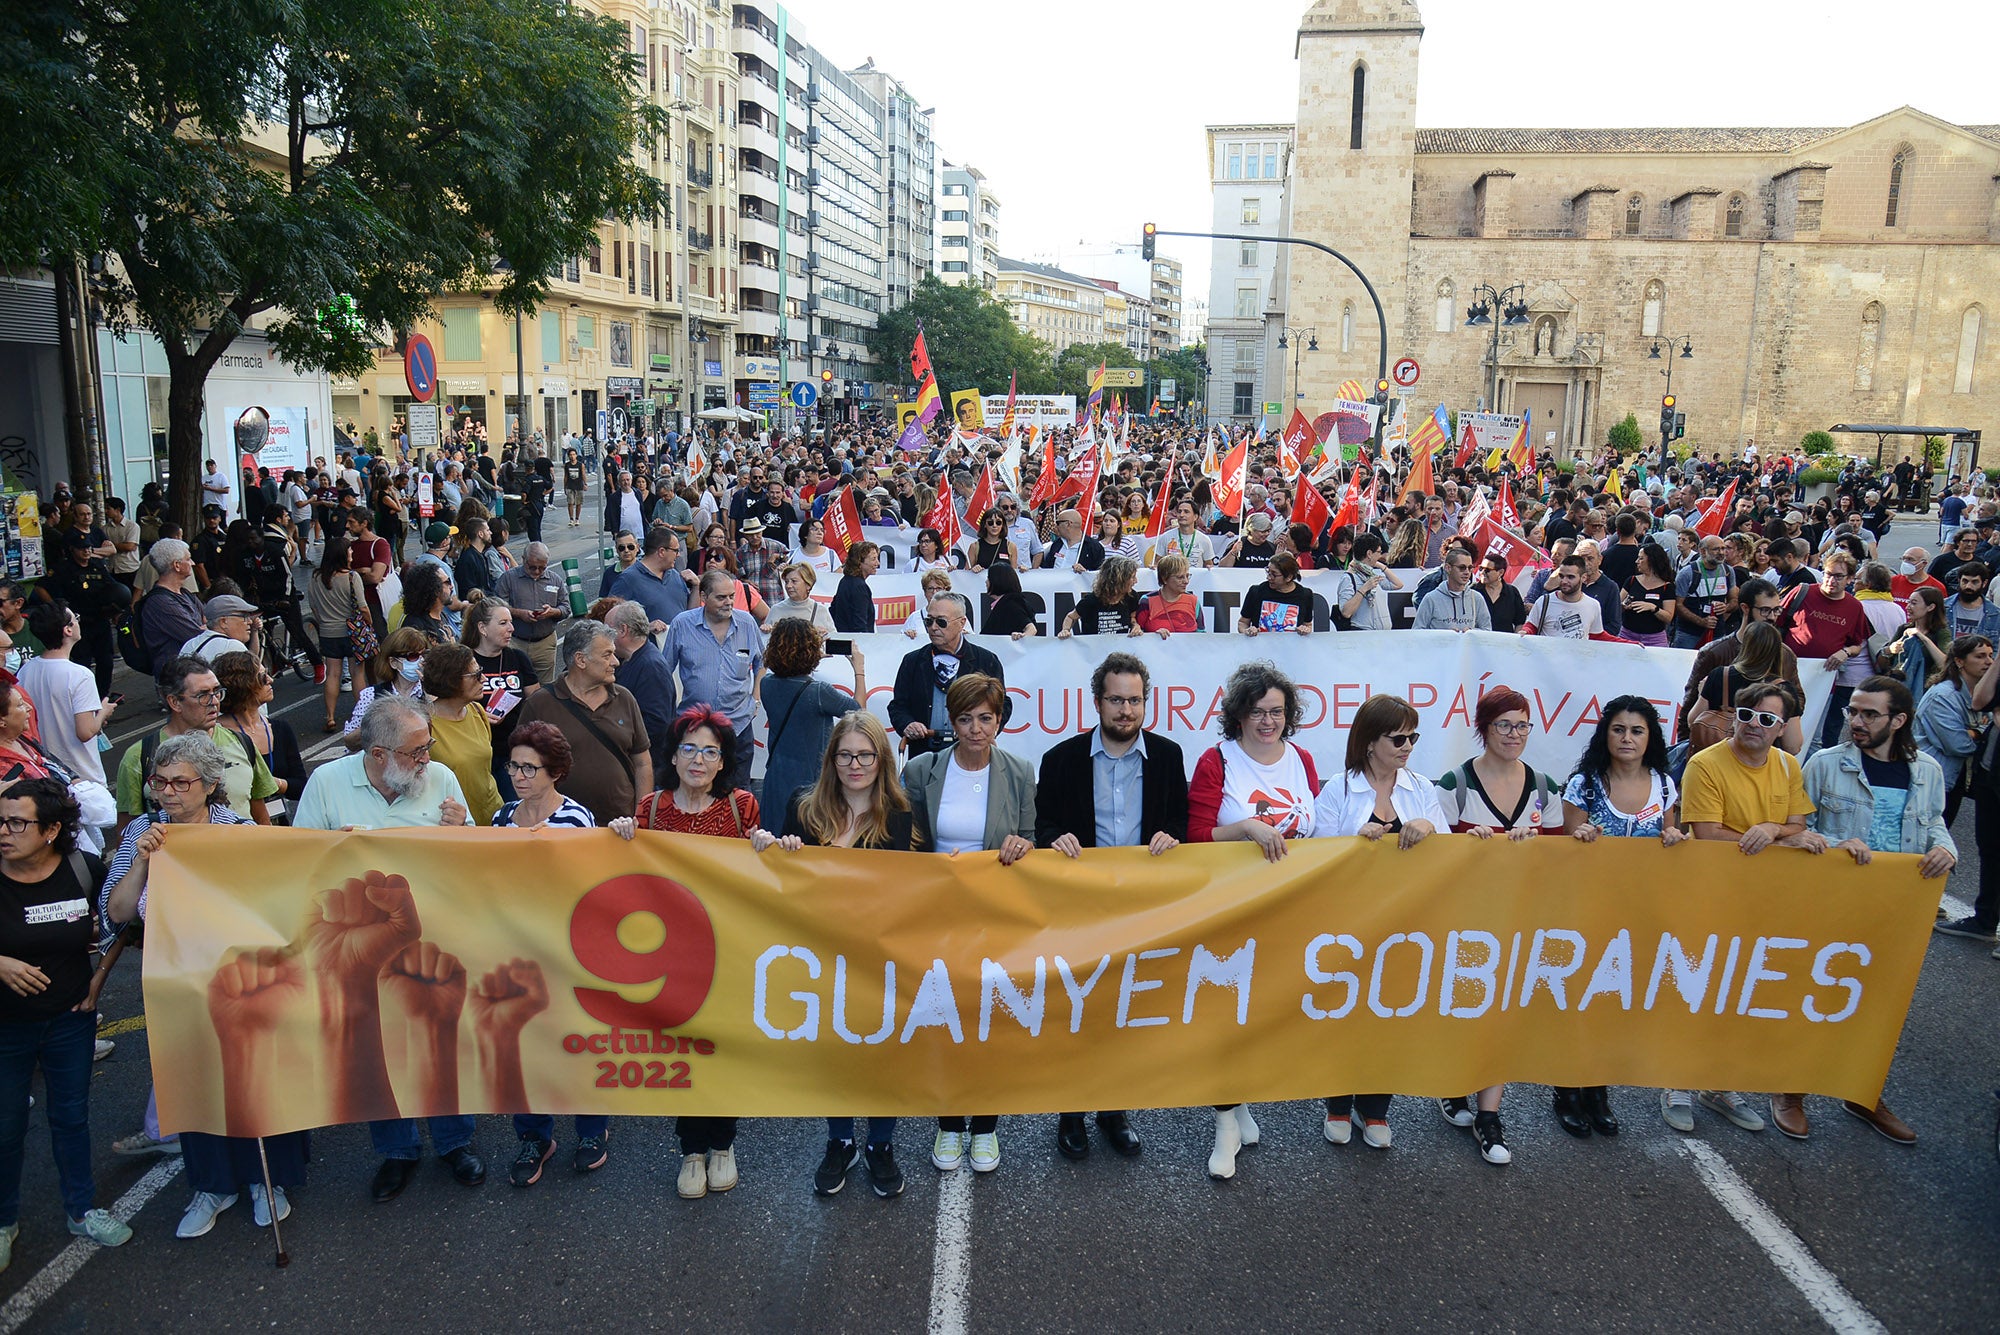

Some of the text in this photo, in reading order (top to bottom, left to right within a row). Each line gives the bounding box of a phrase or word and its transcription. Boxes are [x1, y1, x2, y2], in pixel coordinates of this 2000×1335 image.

[220, 352, 263, 369] farmacia
[26, 913, 55, 923] SENSE
[27, 905, 63, 916] CULTURA
[570, 874, 716, 1029] 9
[754, 928, 1872, 1045] GUANYEM SOBIRANIES
[562, 1026, 715, 1055] octubre
[595, 1061, 692, 1088] 2022
